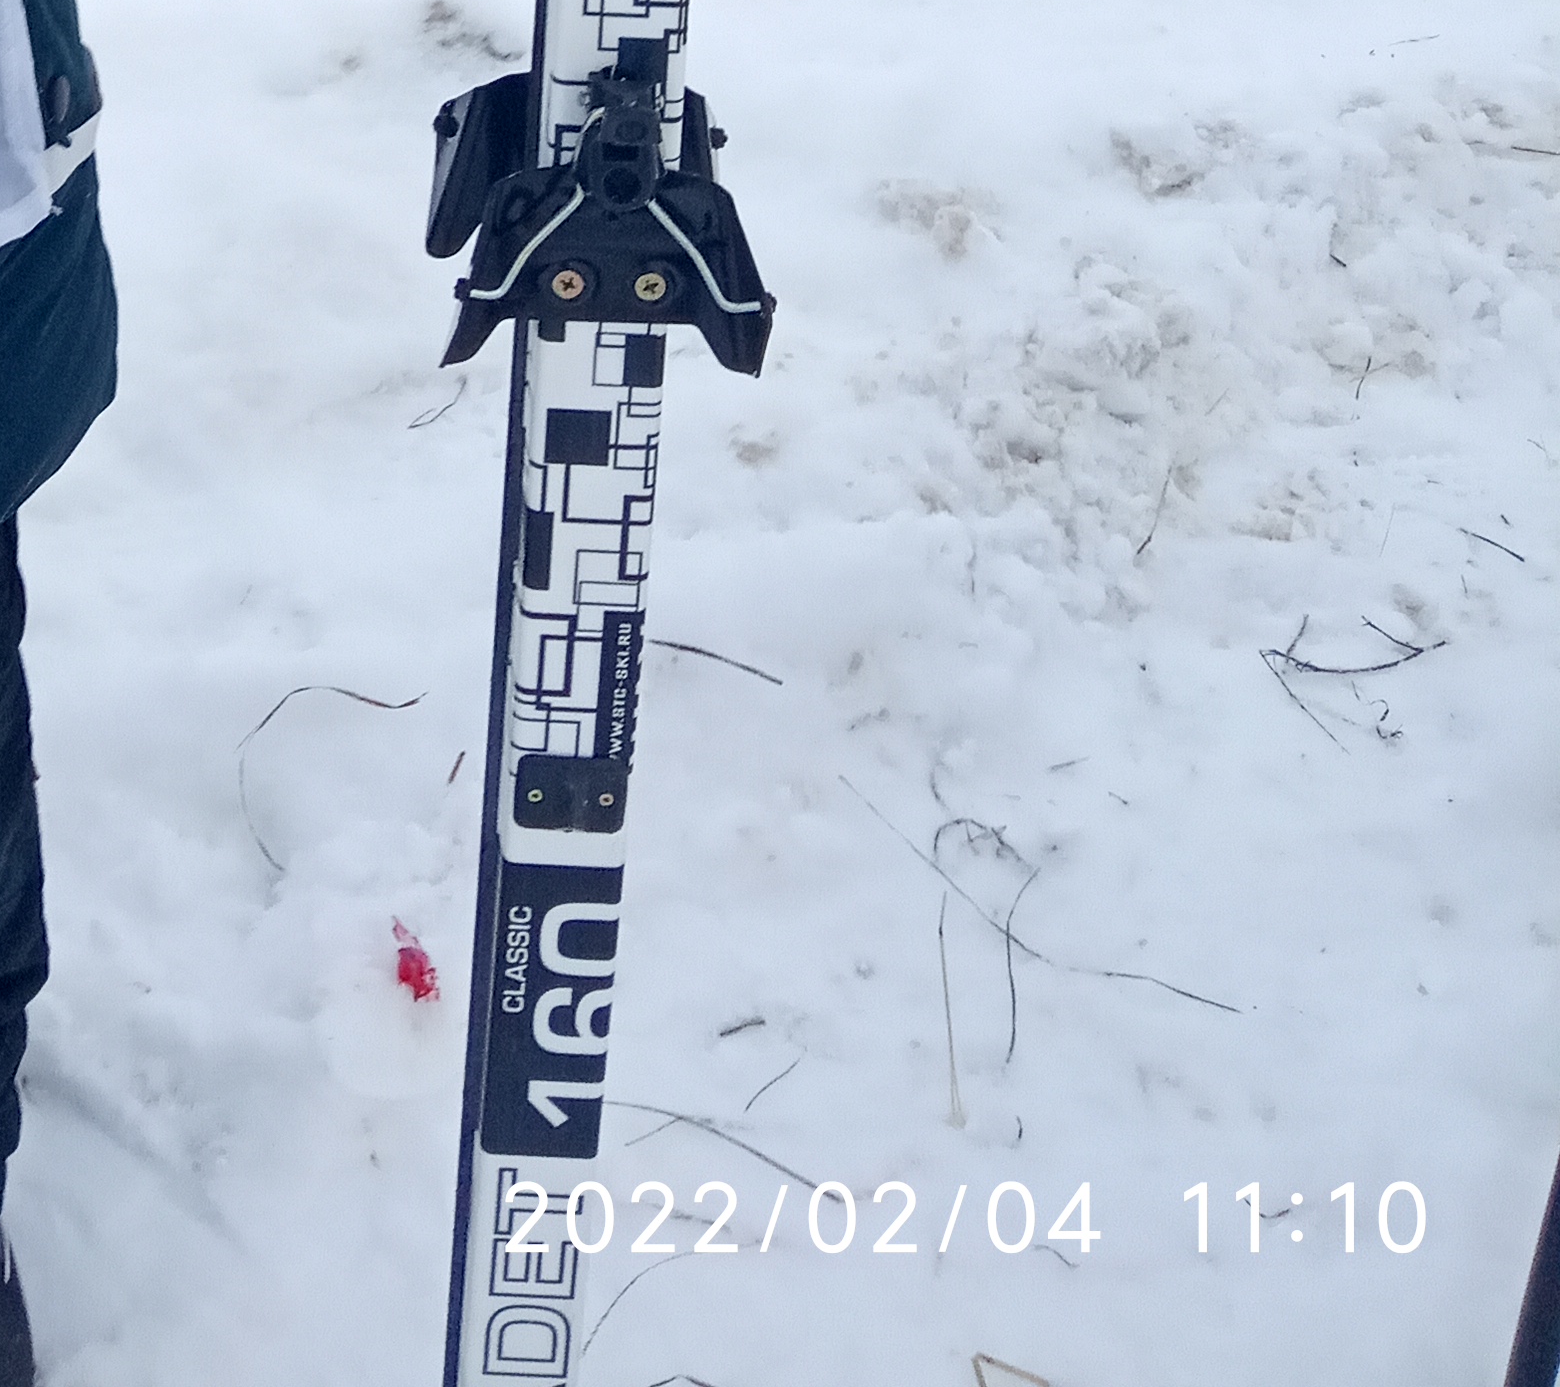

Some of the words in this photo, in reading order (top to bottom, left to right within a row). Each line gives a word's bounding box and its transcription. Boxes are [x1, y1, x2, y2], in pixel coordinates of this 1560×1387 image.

[608, 622, 633, 761] WW.STC-SKI.RU
[501, 904, 532, 1014] CLASSIC
[526, 901, 621, 1129] 160
[482, 1167, 585, 1387] DET
